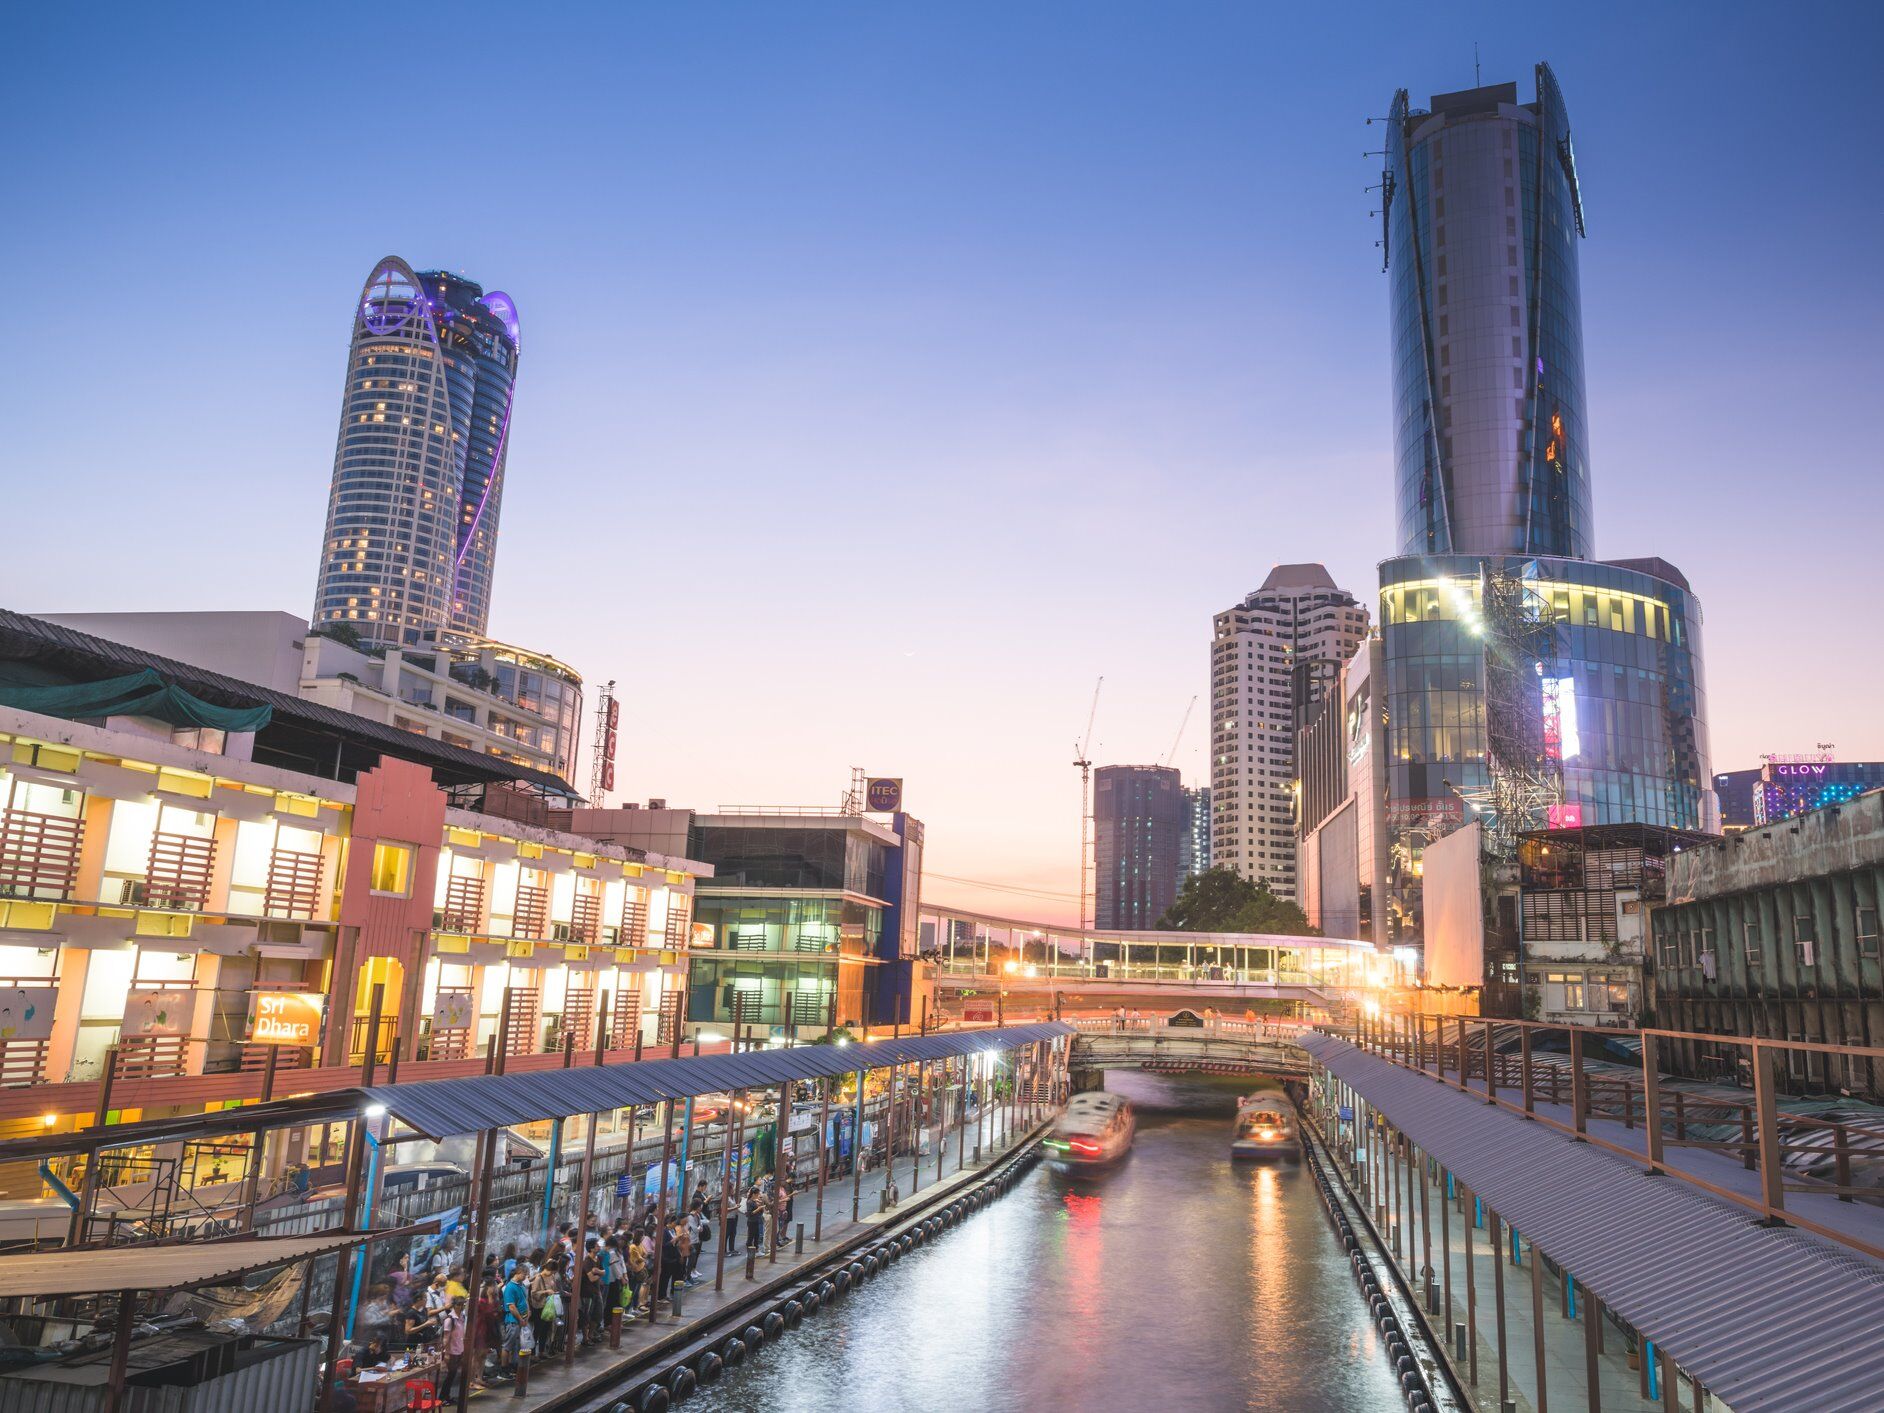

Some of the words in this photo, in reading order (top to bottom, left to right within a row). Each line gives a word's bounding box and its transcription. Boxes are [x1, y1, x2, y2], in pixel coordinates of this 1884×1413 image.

[1779, 766, 1825, 774] GLOW
[872, 787, 898, 796] ITEC
[261, 997, 285, 1014] Sri
[257, 1017, 309, 1036] Dhara
